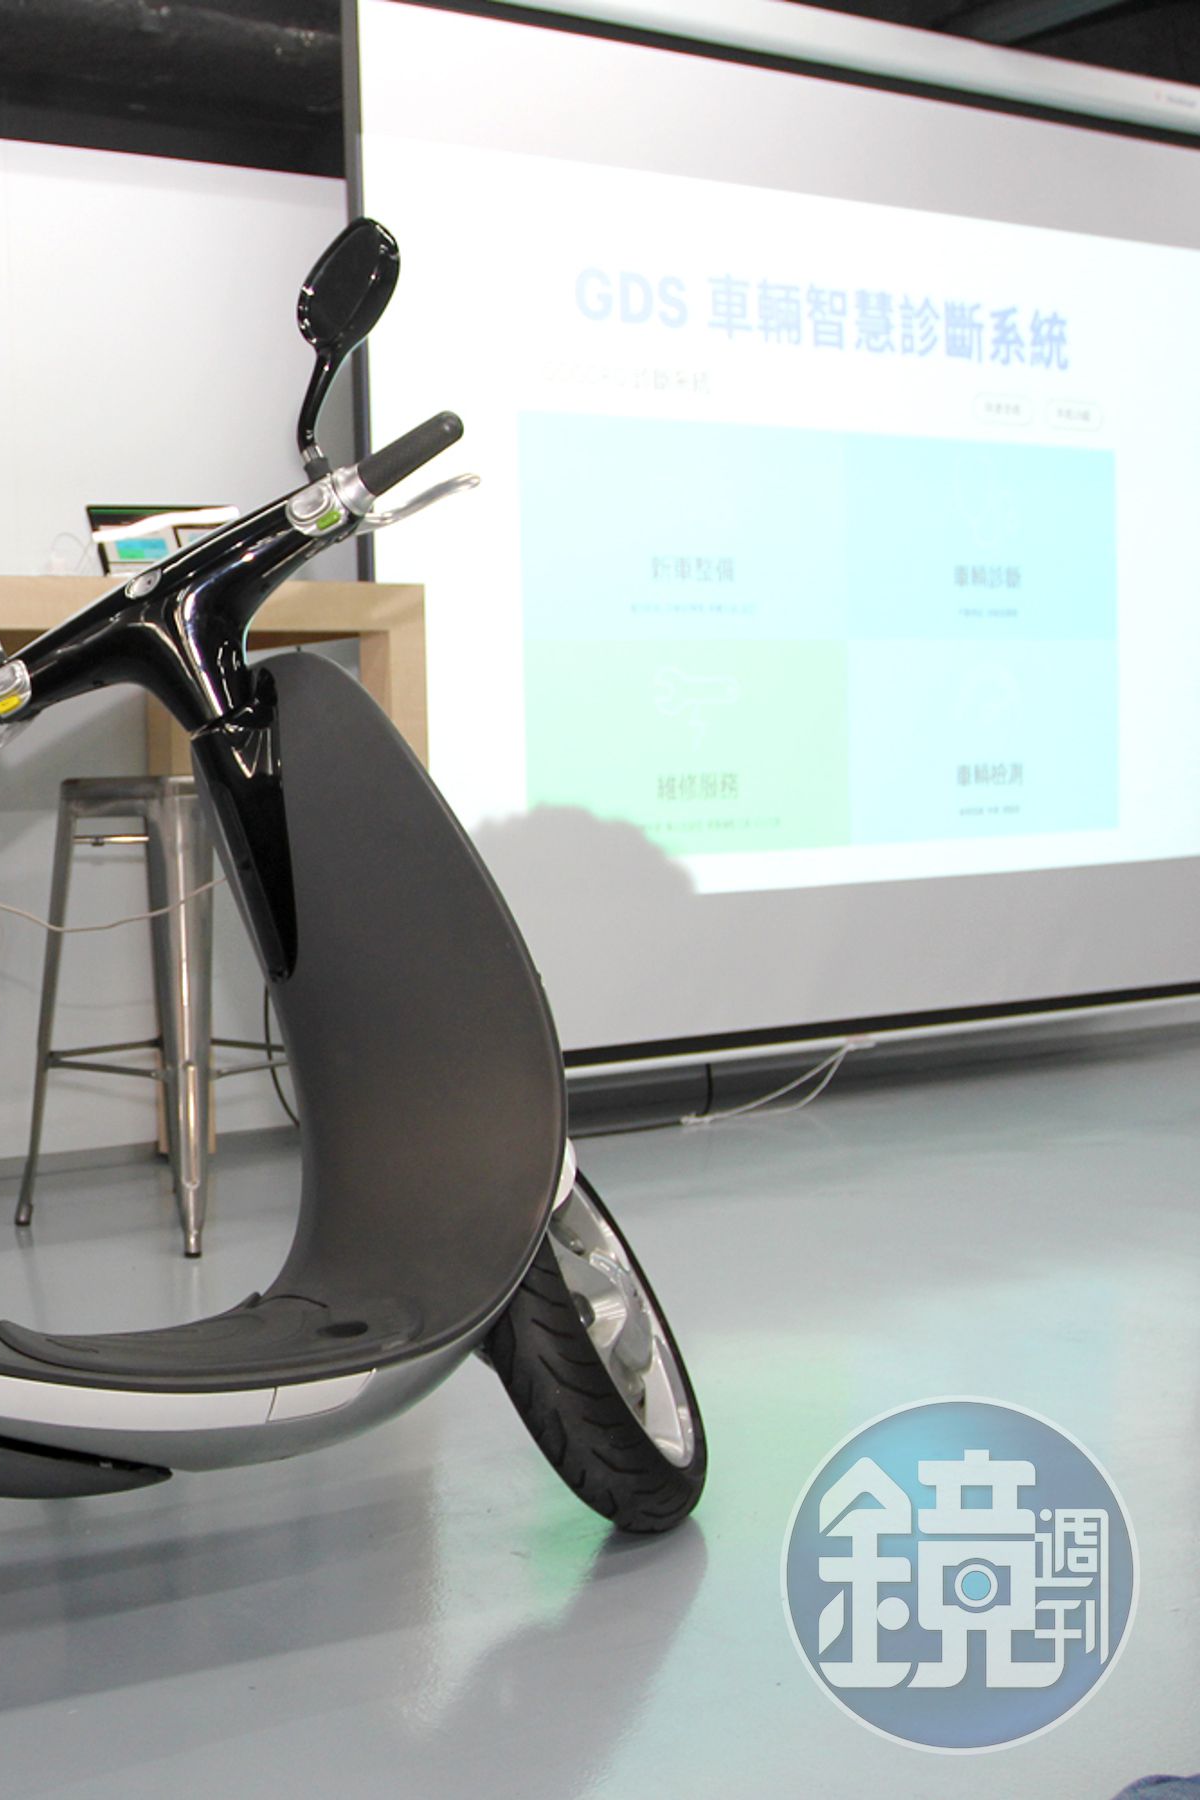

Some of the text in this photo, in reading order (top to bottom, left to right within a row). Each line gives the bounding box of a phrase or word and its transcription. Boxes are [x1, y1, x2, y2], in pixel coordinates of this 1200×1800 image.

[575, 267, 1068, 371] GDS 車輛智慧診斷系統
